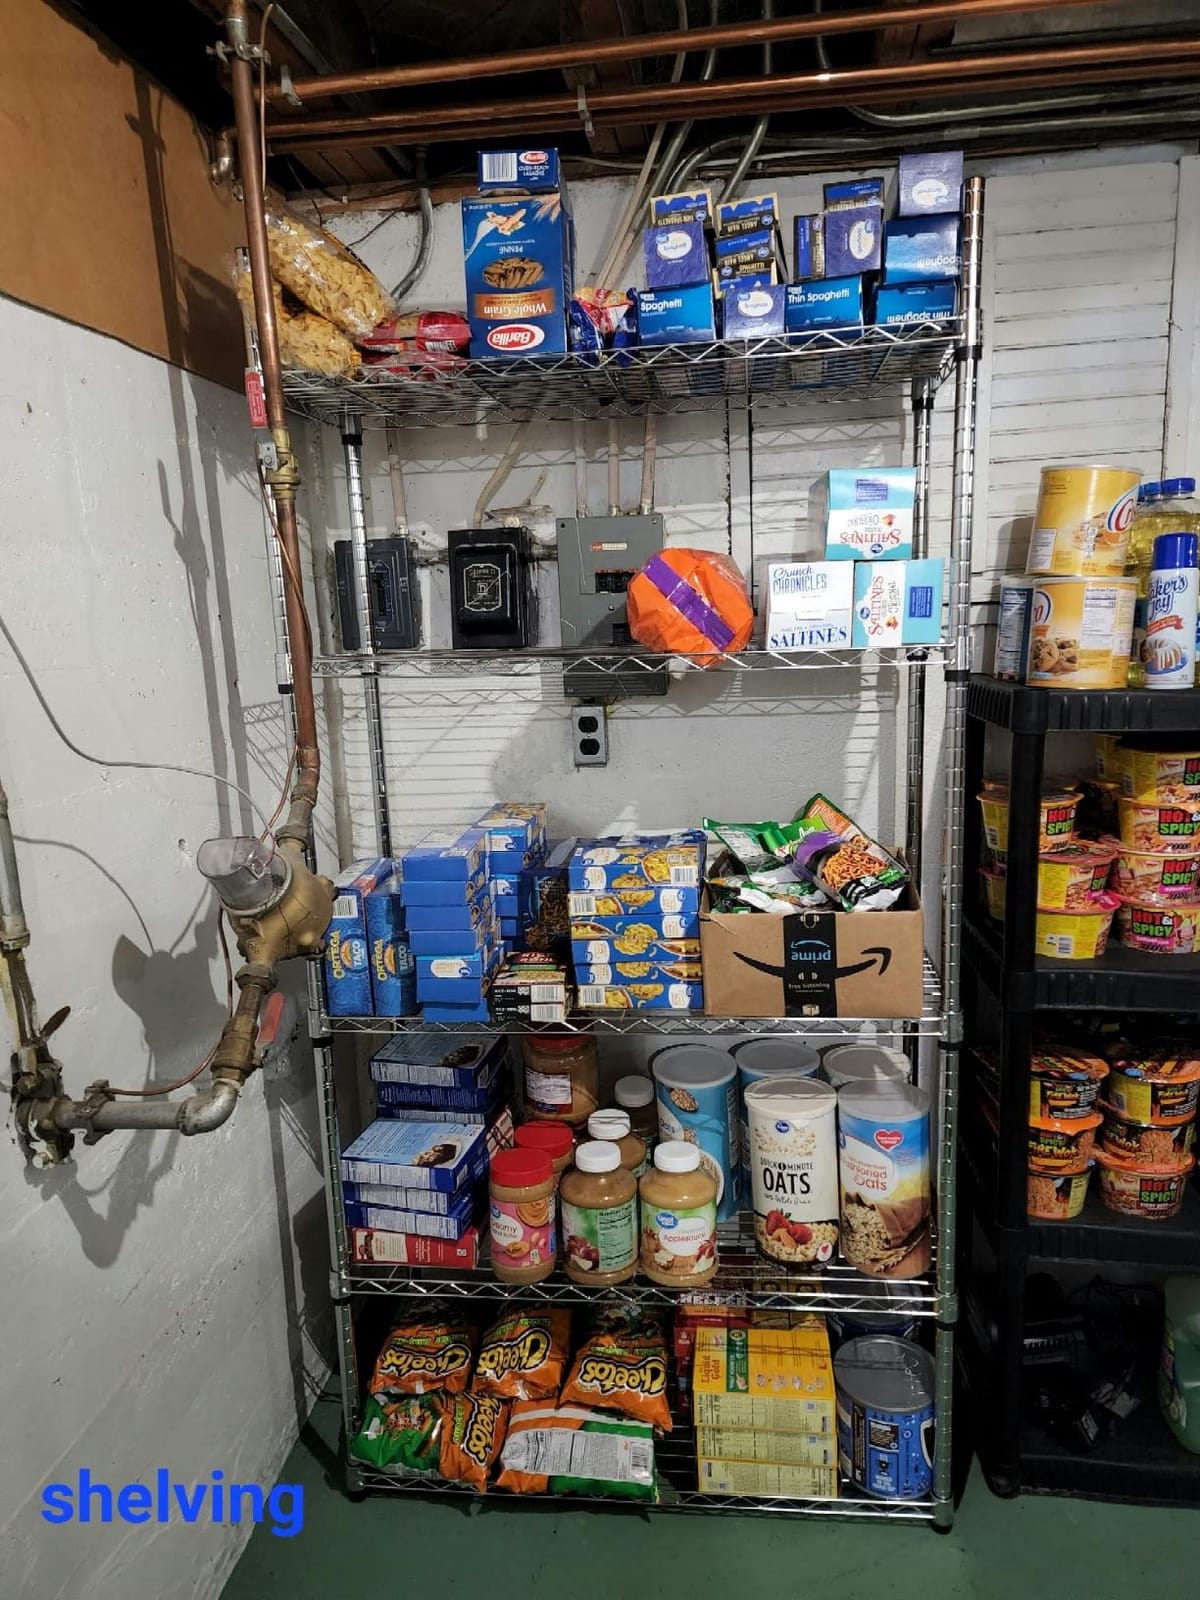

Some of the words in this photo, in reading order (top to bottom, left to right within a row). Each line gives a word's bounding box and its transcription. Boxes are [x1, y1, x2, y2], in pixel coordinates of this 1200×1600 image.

[498, 245, 524, 254] PENNE
[787, 294, 805, 304] Thin
[807, 288, 850, 302] Spaghetti
[483, 305, 512, 317] Grain
[514, 303, 547, 315] Whole
[640, 297, 682, 311] Spaghetti
[492, 331, 531, 345] Barilla
[840, 528, 901, 545] SALTINES
[773, 565, 813, 579] Crunch
[772, 574, 827, 595] CHRONICLES
[869, 576, 884, 636] SALTINES
[770, 626, 847, 648] SALTINES
[1048, 809, 1071, 823] HOT
[1159, 823, 1200, 835] SPICY
[1164, 860, 1191, 873] HOT
[1163, 872, 1196, 885] SPICY
[1132, 911, 1161, 925] HOT
[1132, 923, 1173, 937] SPICY
[329, 930, 346, 979] ORTEGA
[352, 940, 362, 967] TACO
[374, 939, 388, 981] ORTEGA
[398, 945, 408, 972] TACO
[791, 949, 831, 964] prime
[787, 1161, 814, 1171] MINUTE
[763, 1167, 811, 1195] OATS
[1140, 1180, 1169, 1191] HOT
[1141, 1190, 1176, 1203] SPICY
[663, 1232, 706, 1243] Applesauce
[477, 1332, 549, 1373] Cheetos
[384, 1346, 468, 1375] Cheetos
[582, 1358, 665, 1393] Cheetos
[468, 1396, 500, 1461] heetos
